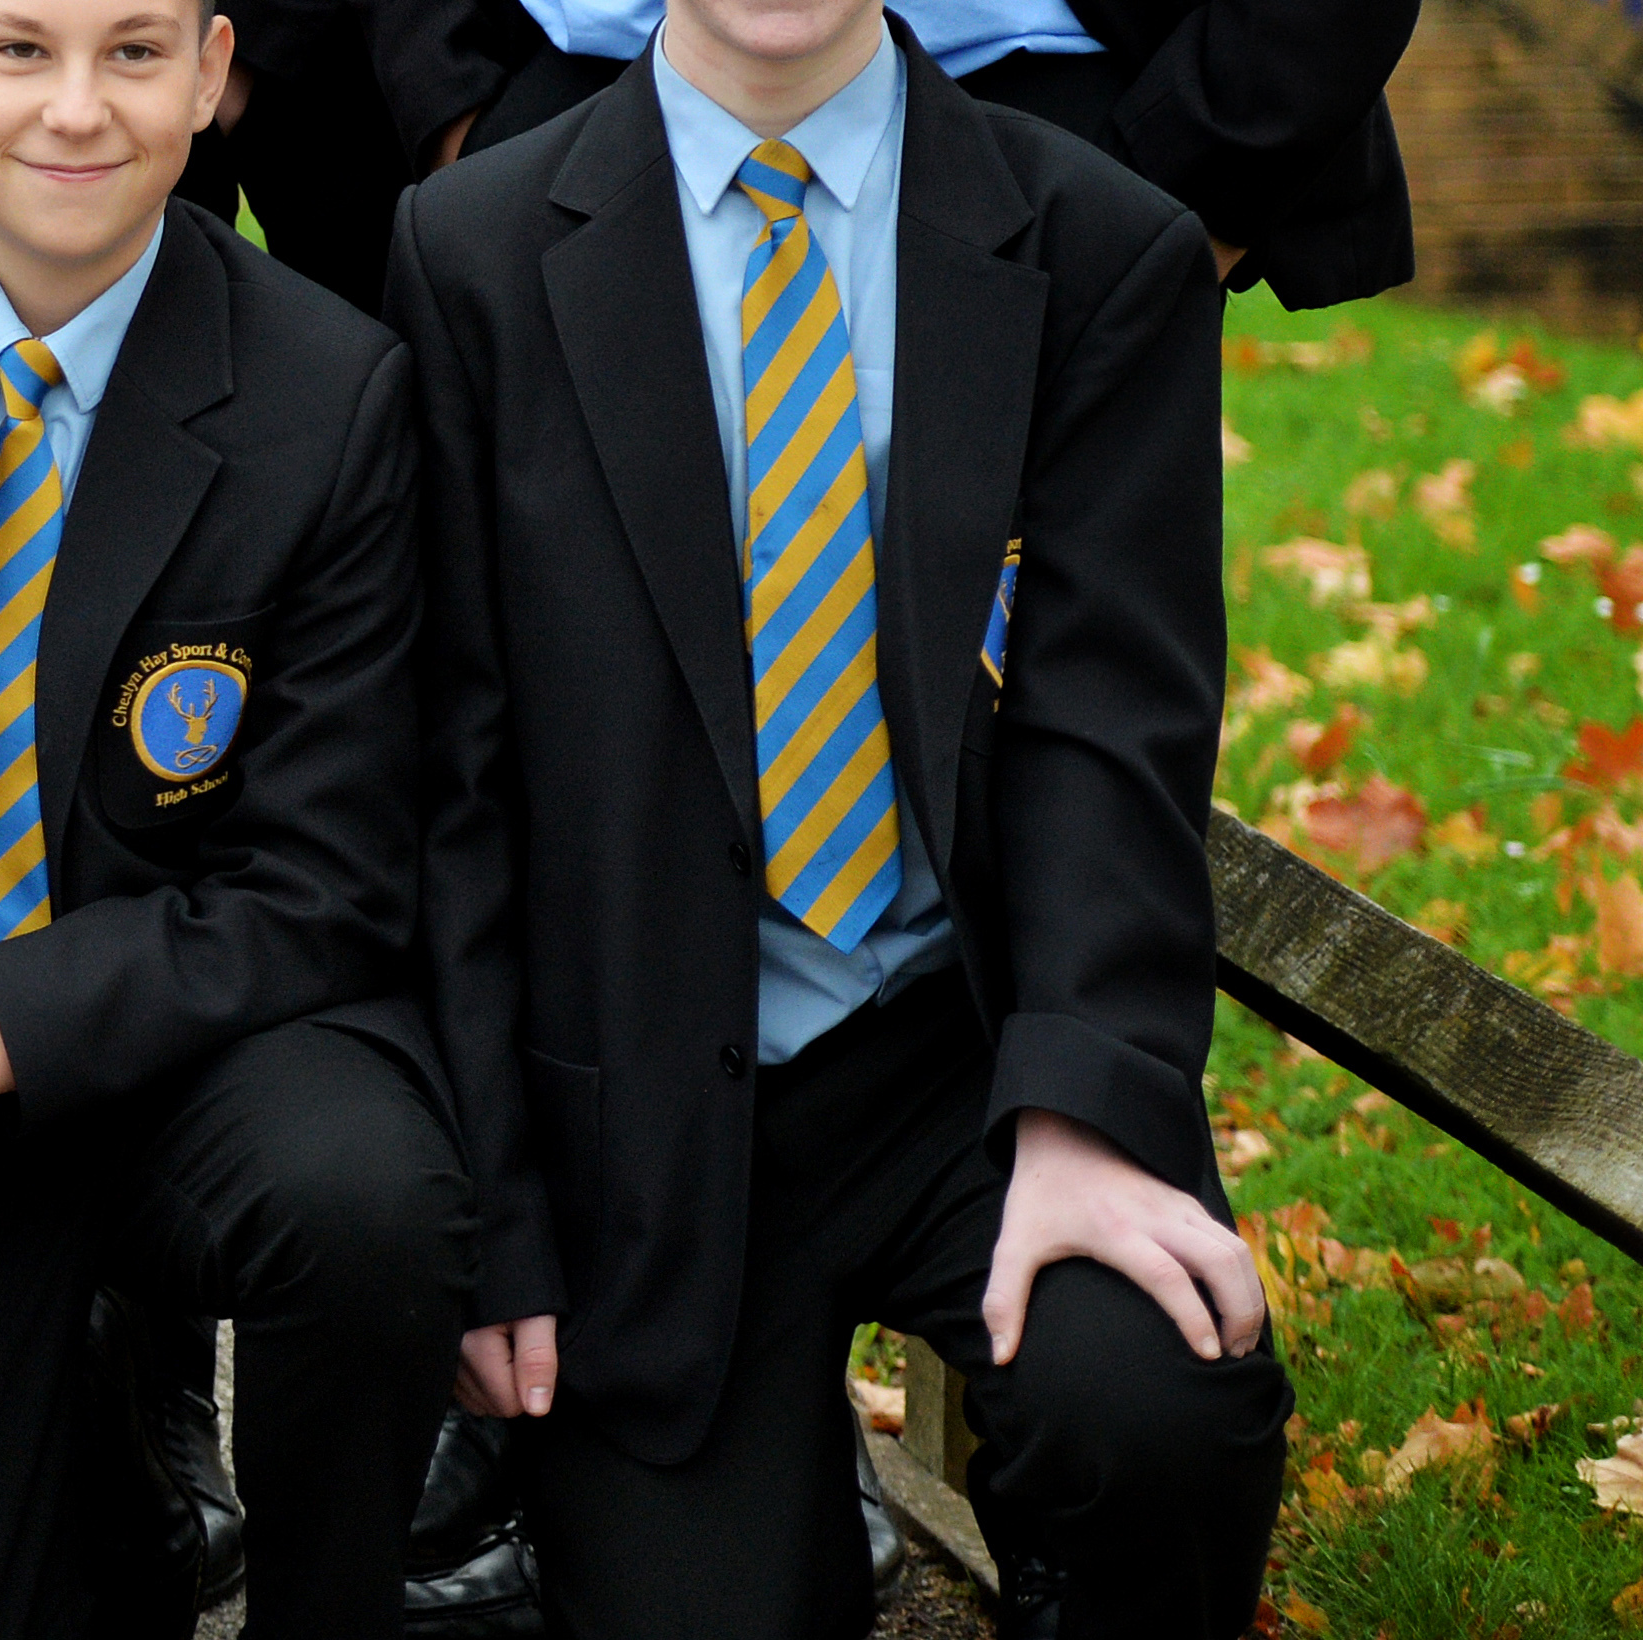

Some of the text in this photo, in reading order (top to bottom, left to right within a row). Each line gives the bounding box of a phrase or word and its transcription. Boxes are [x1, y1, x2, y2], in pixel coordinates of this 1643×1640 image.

[112, 642, 228, 728] Cheslyn Hay Sport &
[155, 771, 228, 808] High School
